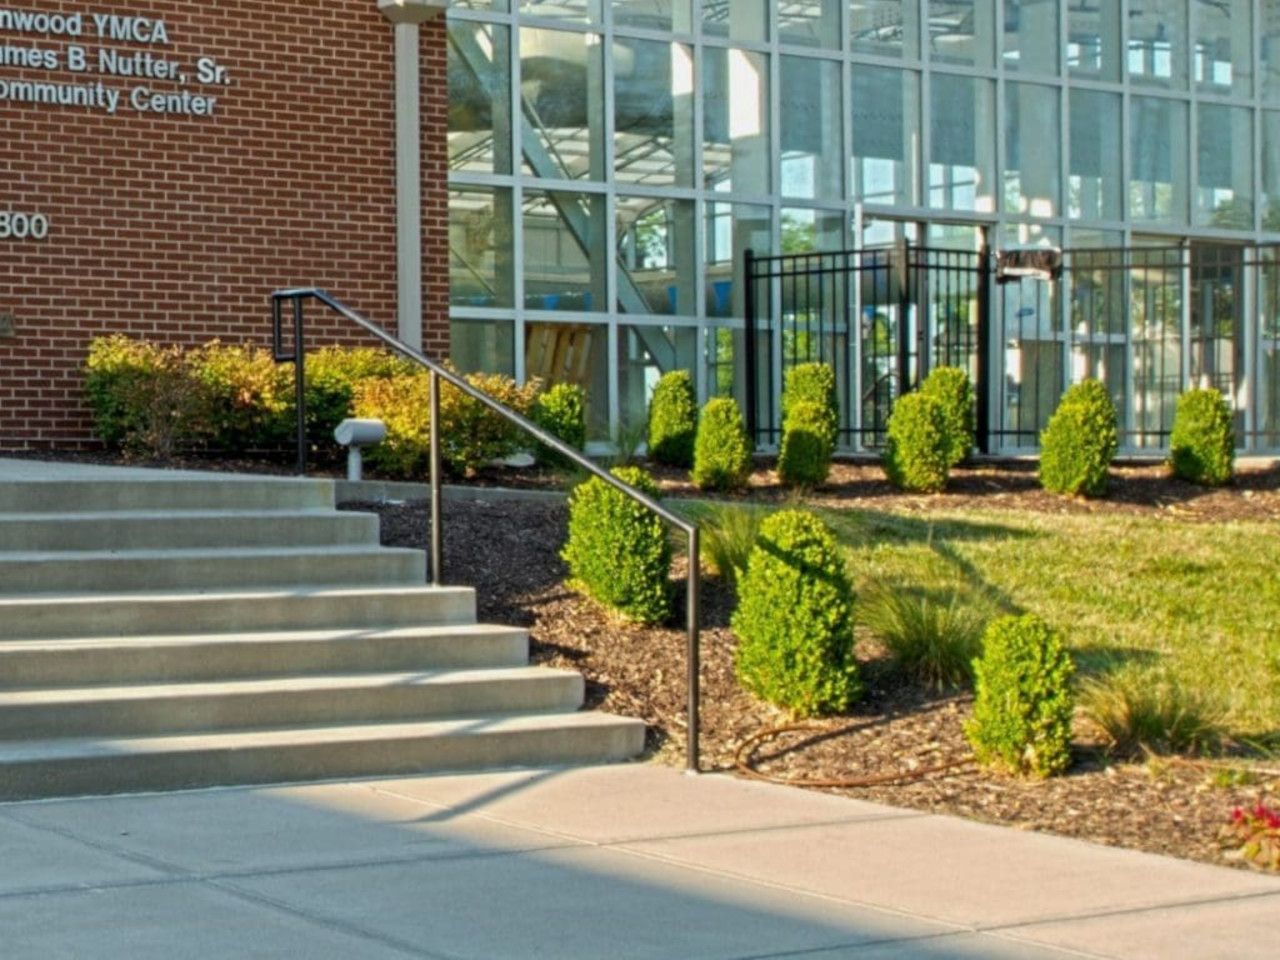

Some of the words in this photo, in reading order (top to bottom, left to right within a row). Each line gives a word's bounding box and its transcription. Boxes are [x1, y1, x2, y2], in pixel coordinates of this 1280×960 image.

[92, 14, 169, 44] YMCA
[99, 49, 186, 83] Nutter,
[197, 58, 231, 84] Sr.
[130, 86, 217, 115] Center
